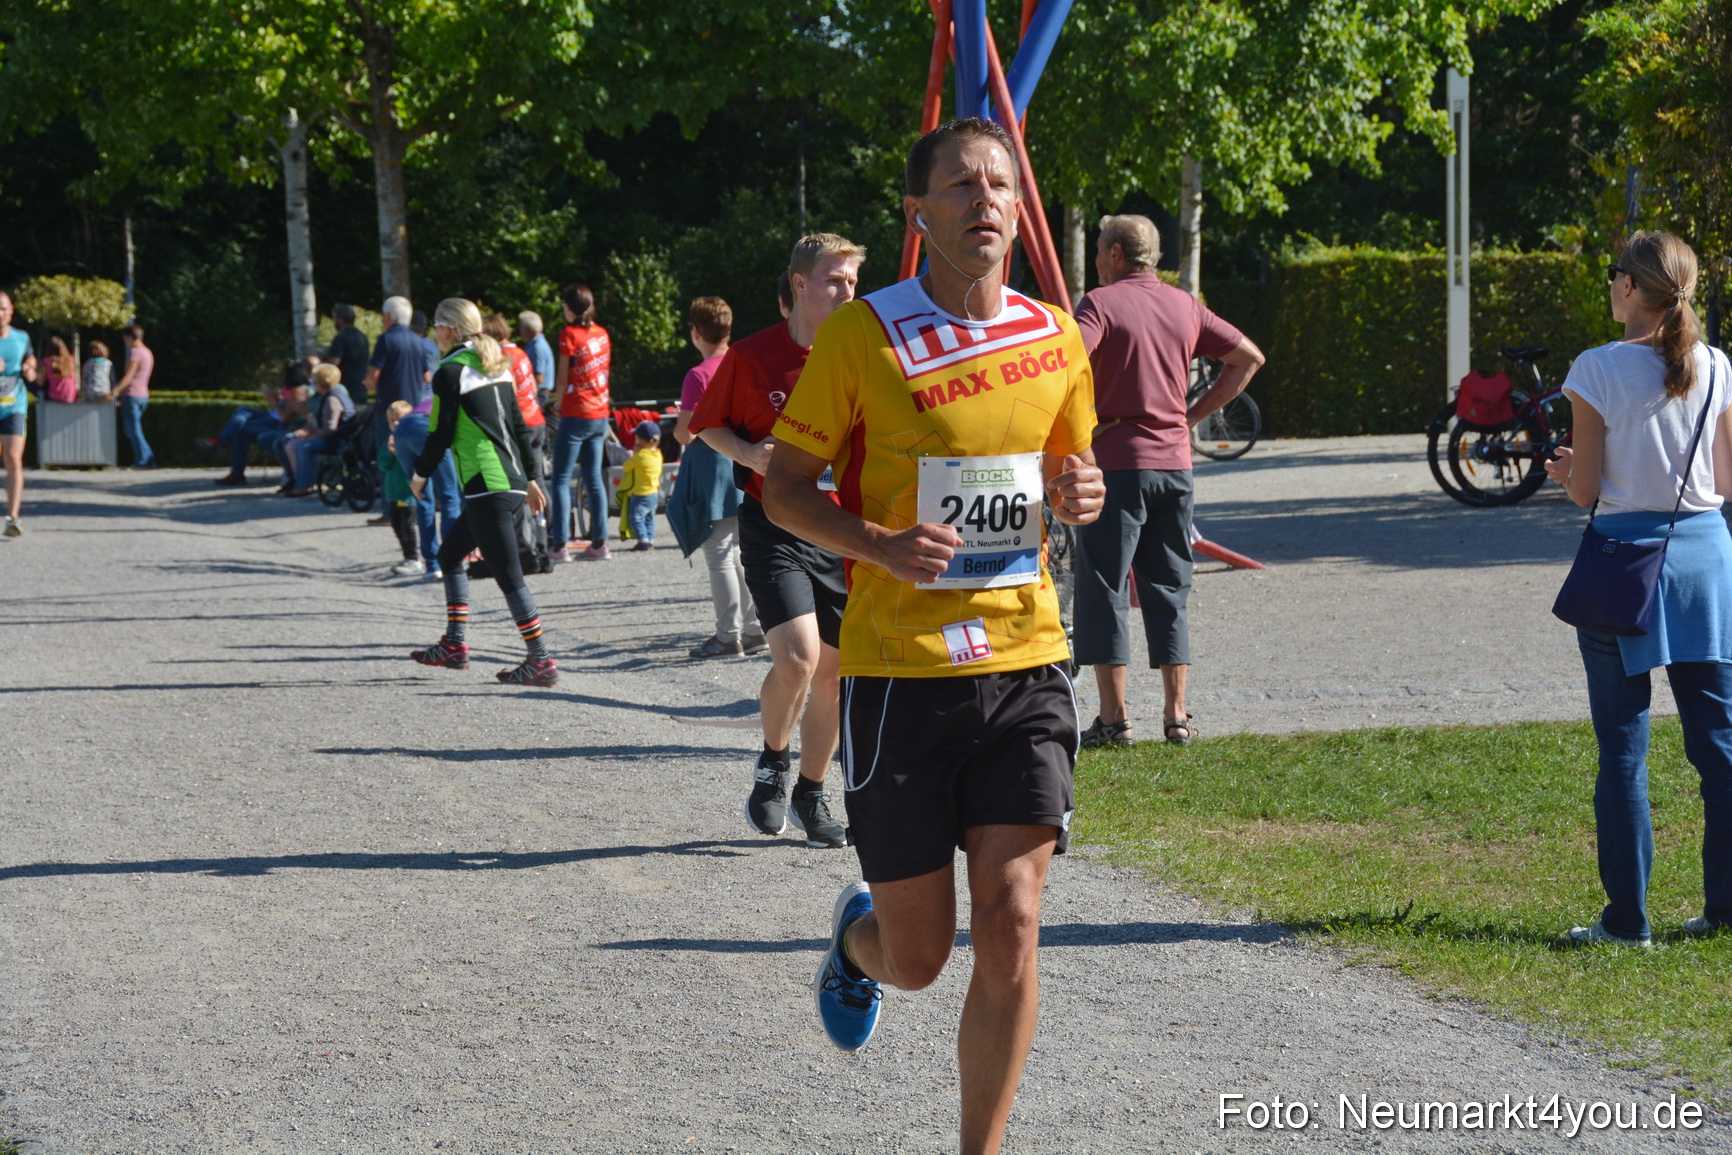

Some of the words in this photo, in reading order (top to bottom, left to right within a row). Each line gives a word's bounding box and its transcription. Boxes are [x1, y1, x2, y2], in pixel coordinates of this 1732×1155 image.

[911, 369, 995, 414] MAX
[999, 347, 1068, 386] BÖGL
[961, 468, 1015, 484] BOCK
[940, 492, 1028, 534] 2406
[977, 538, 1011, 548] Neumarkt
[963, 555, 1006, 575] Bernd
